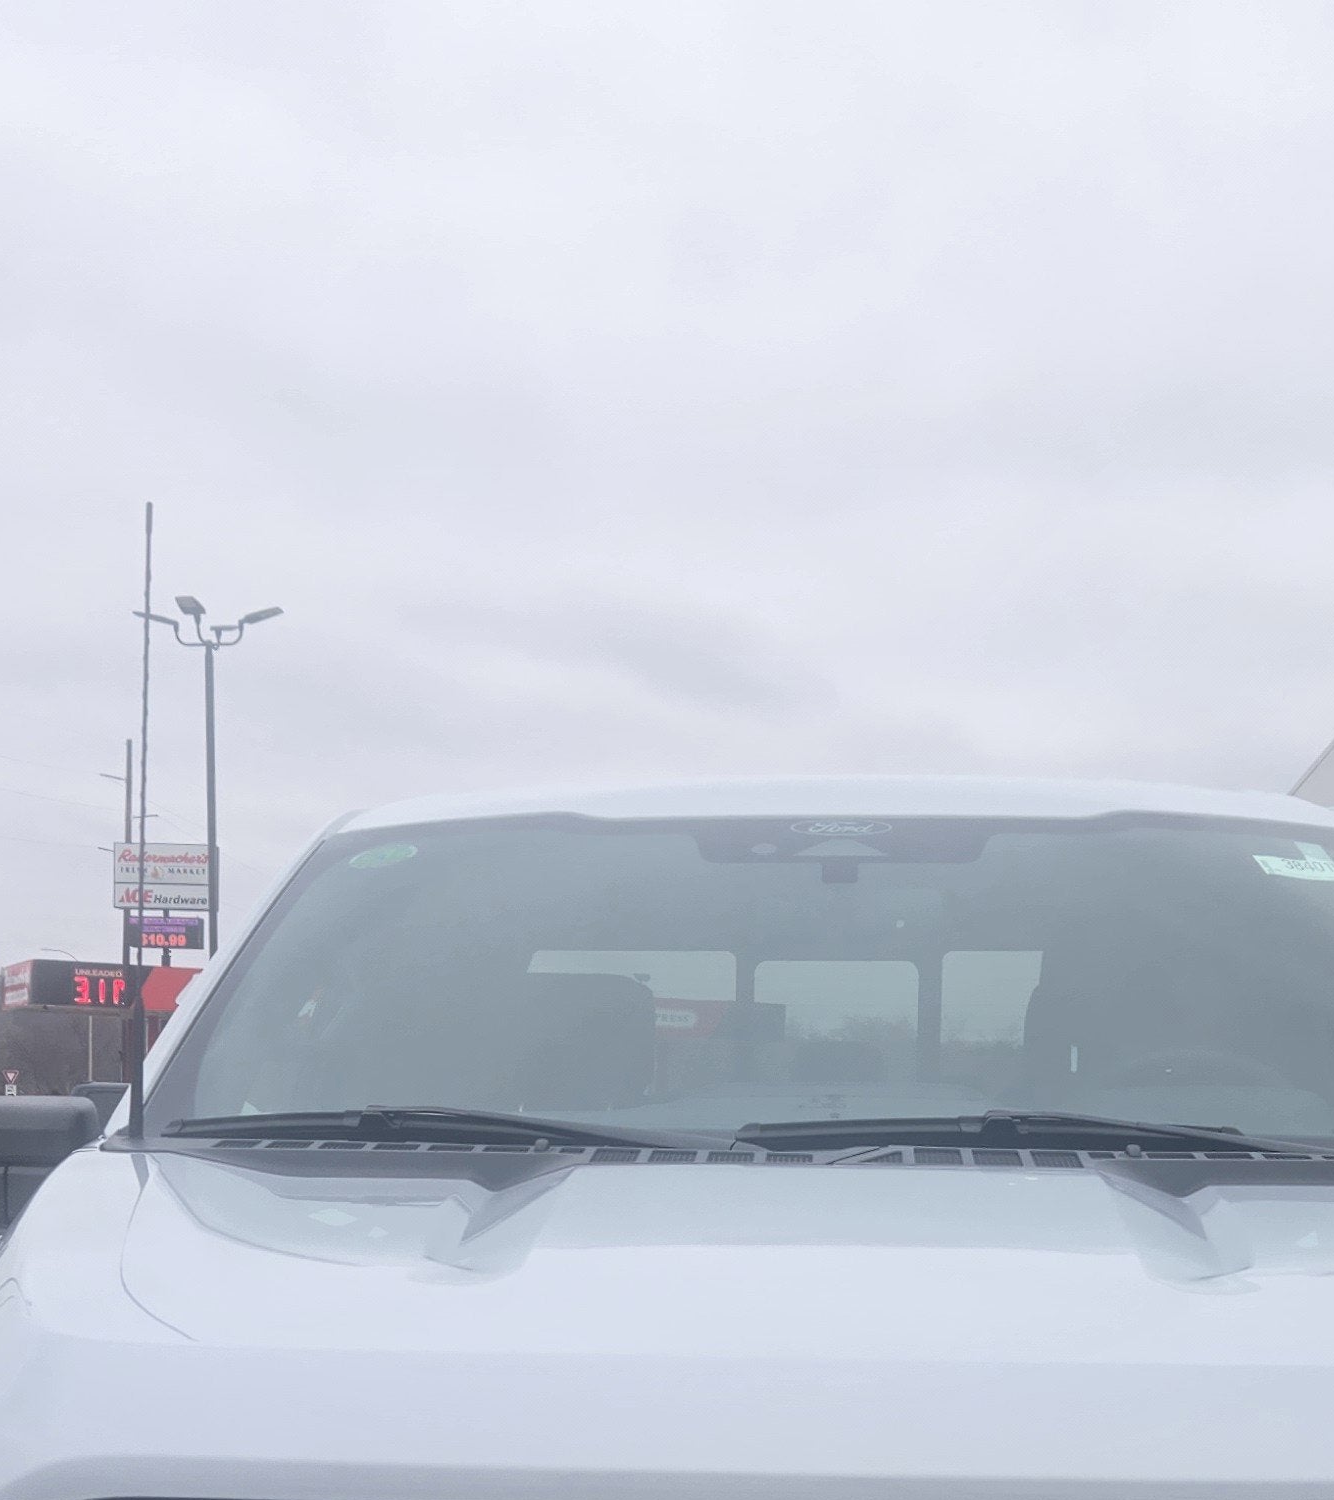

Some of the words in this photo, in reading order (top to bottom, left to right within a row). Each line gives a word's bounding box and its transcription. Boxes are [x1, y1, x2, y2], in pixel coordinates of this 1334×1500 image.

[809, 821, 875, 833] Ford
[168, 868, 206, 876] MARKET
[119, 887, 154, 905] ACE
[154, 894, 208, 906] Hardware
[74, 968, 123, 978] UNLEADED
